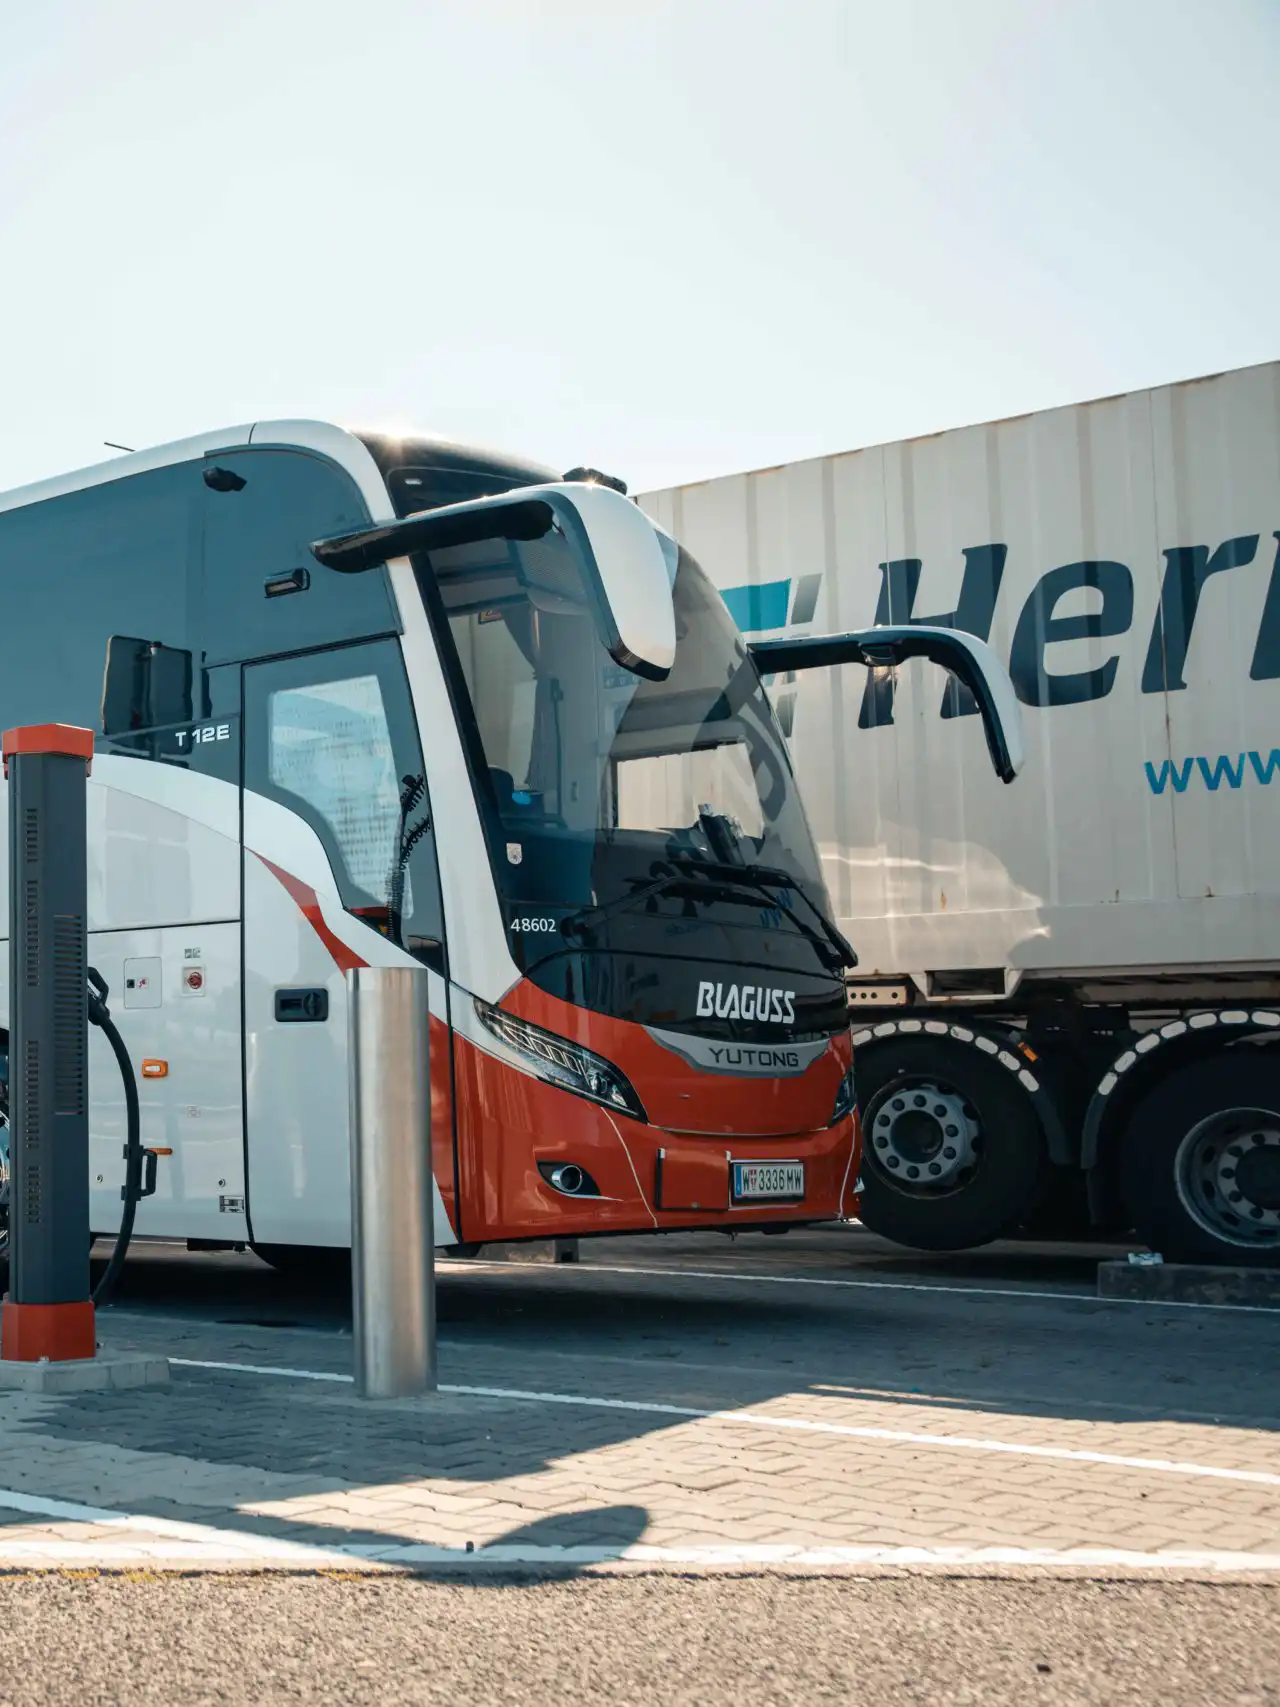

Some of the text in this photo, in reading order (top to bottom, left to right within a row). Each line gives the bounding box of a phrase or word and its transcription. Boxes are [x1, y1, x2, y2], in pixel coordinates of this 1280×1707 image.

[175, 724, 230, 747] T 12E
[510, 917, 557, 932] 48602
[696, 981, 796, 1024] BLAGUSS
[708, 1047, 799, 1068] YUTONG
